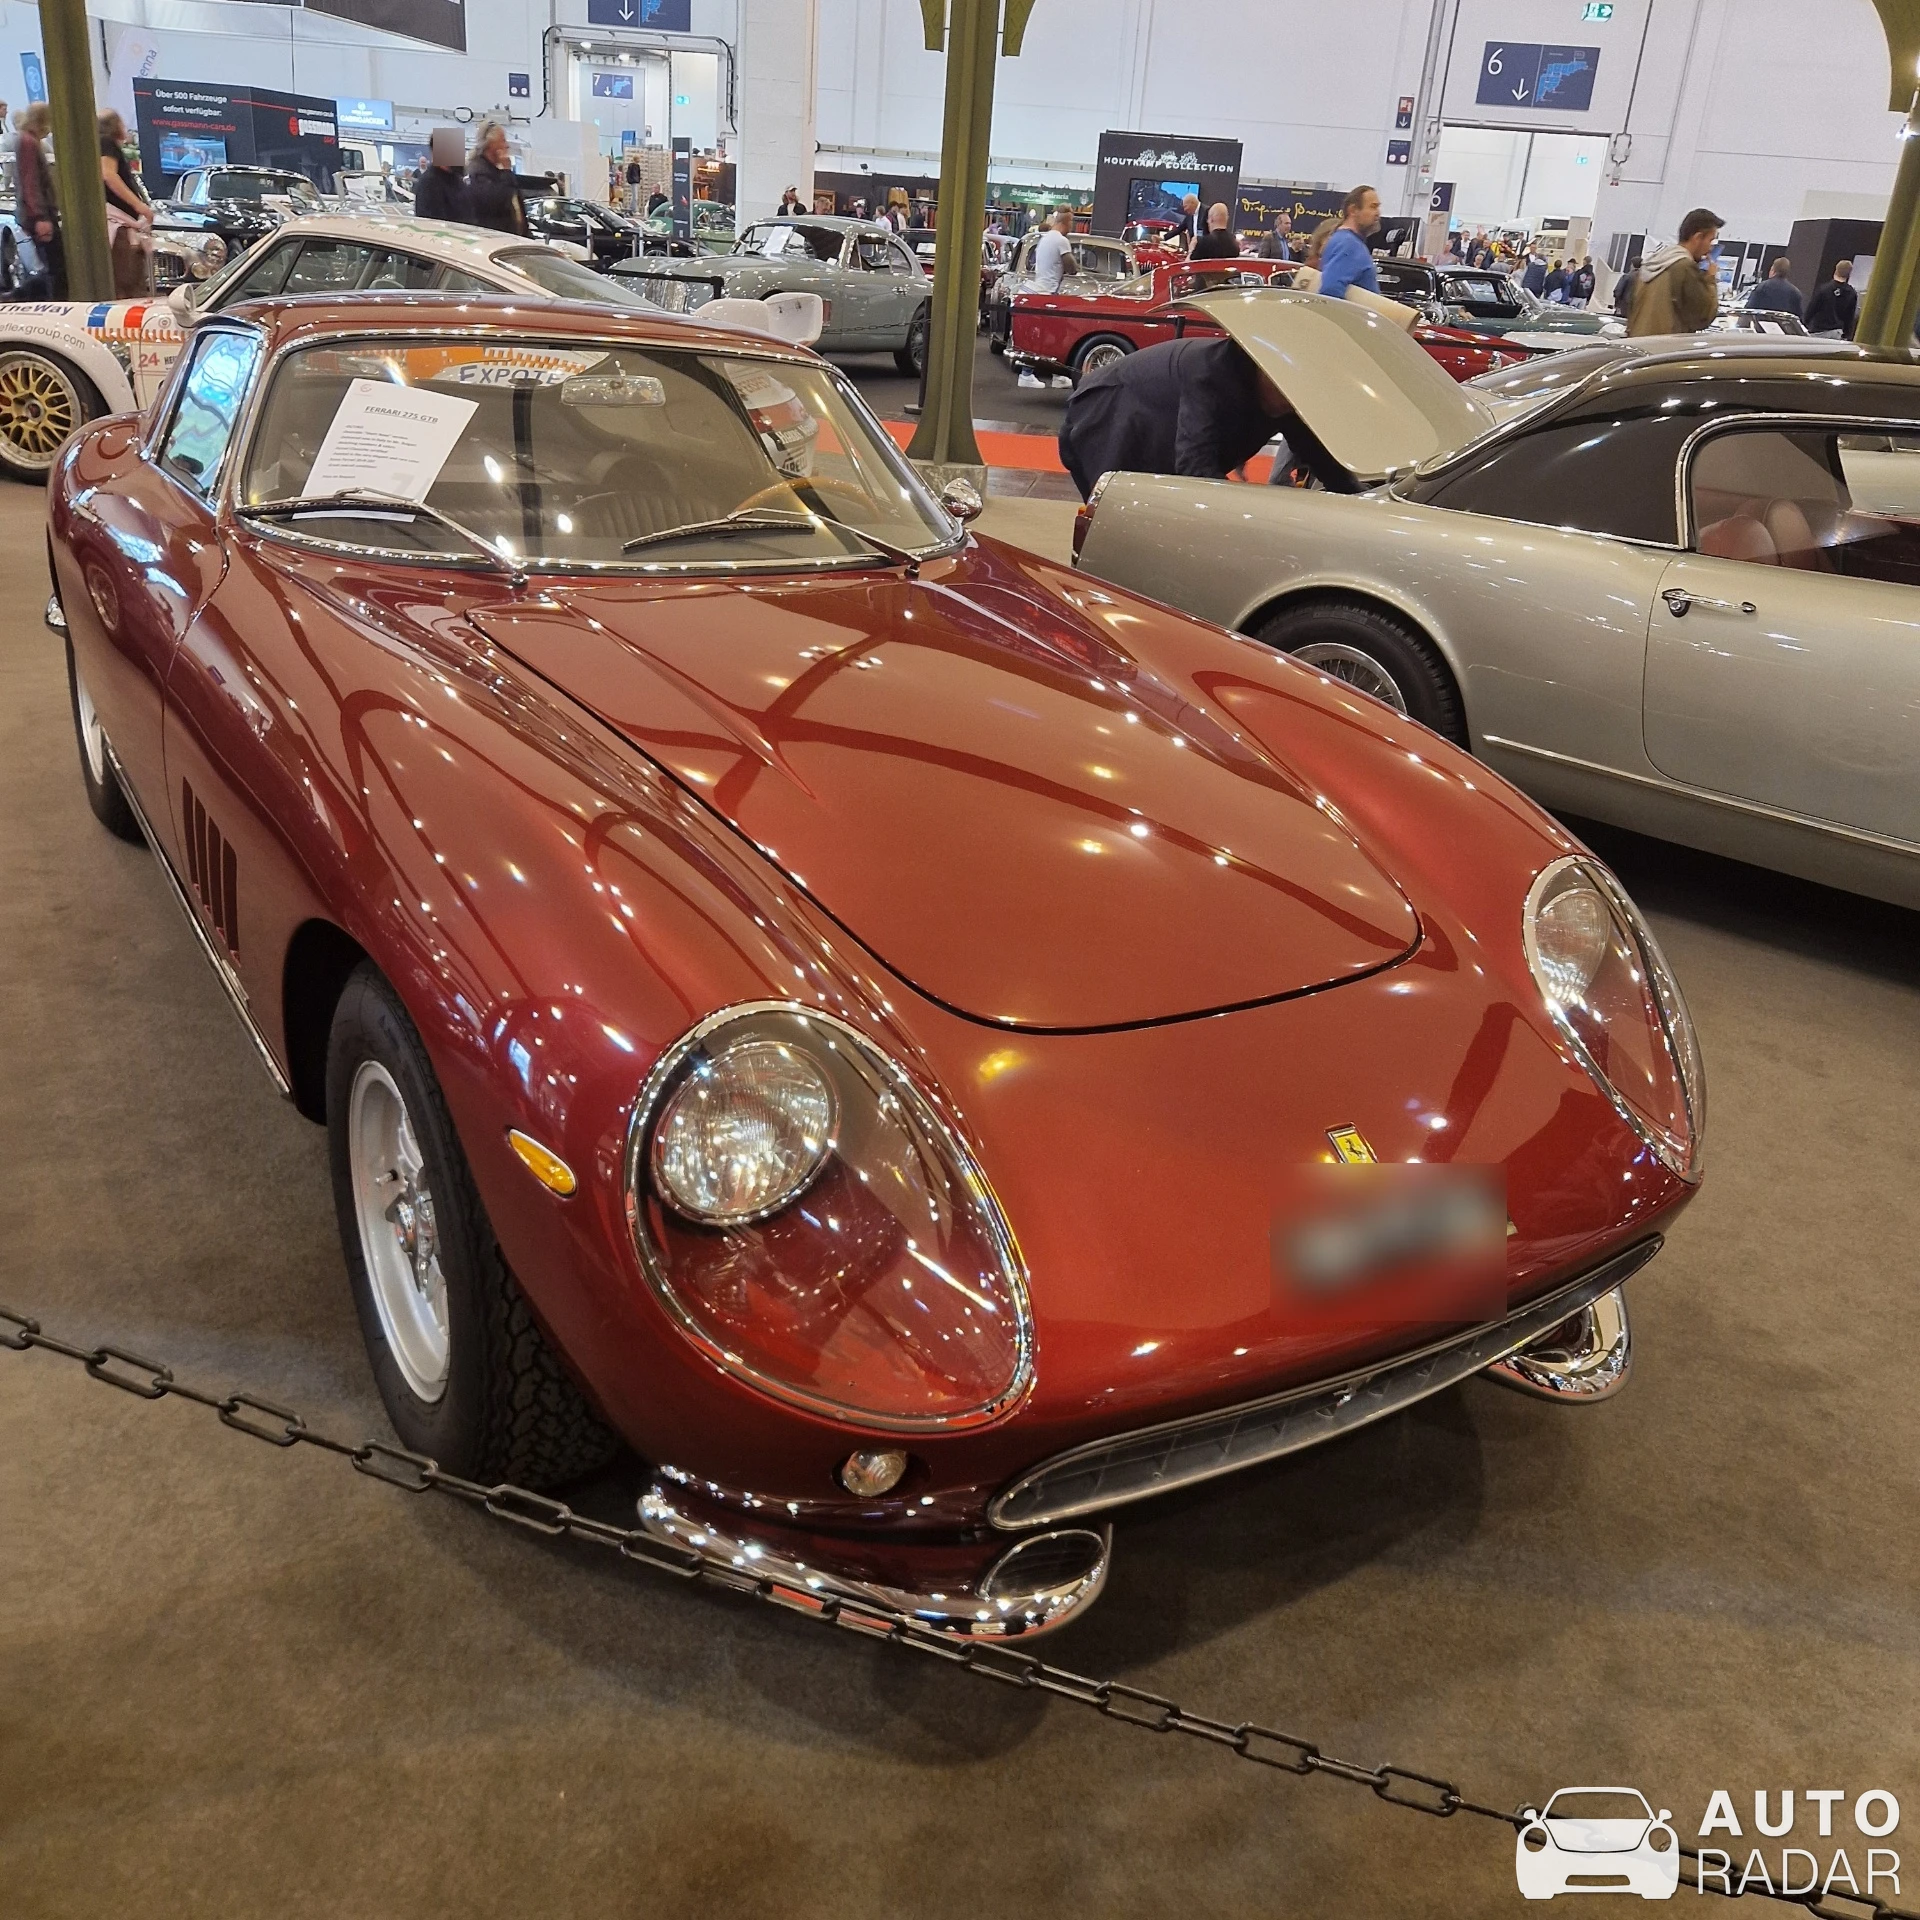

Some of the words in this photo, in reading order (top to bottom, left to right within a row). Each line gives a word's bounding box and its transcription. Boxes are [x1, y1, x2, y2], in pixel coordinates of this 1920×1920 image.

[1487, 48, 1504, 75] 6
[593, 75, 601, 86] 7
[155, 88, 174, 99] Über
[174, 91, 188, 100] 500
[189, 92, 228, 104] Fahrzeuge
[162, 105, 184, 113] sofort
[1103, 156, 1162, 168] HOUTKAMP
[1165, 161, 1234, 173] COLLECTION
[1430, 187, 1442, 207] 6
[138, 352, 160, 368] 24
[364, 406, 401, 416] FERRARI
[402, 411, 418, 419] 275
[420, 415, 439, 423] GTB
